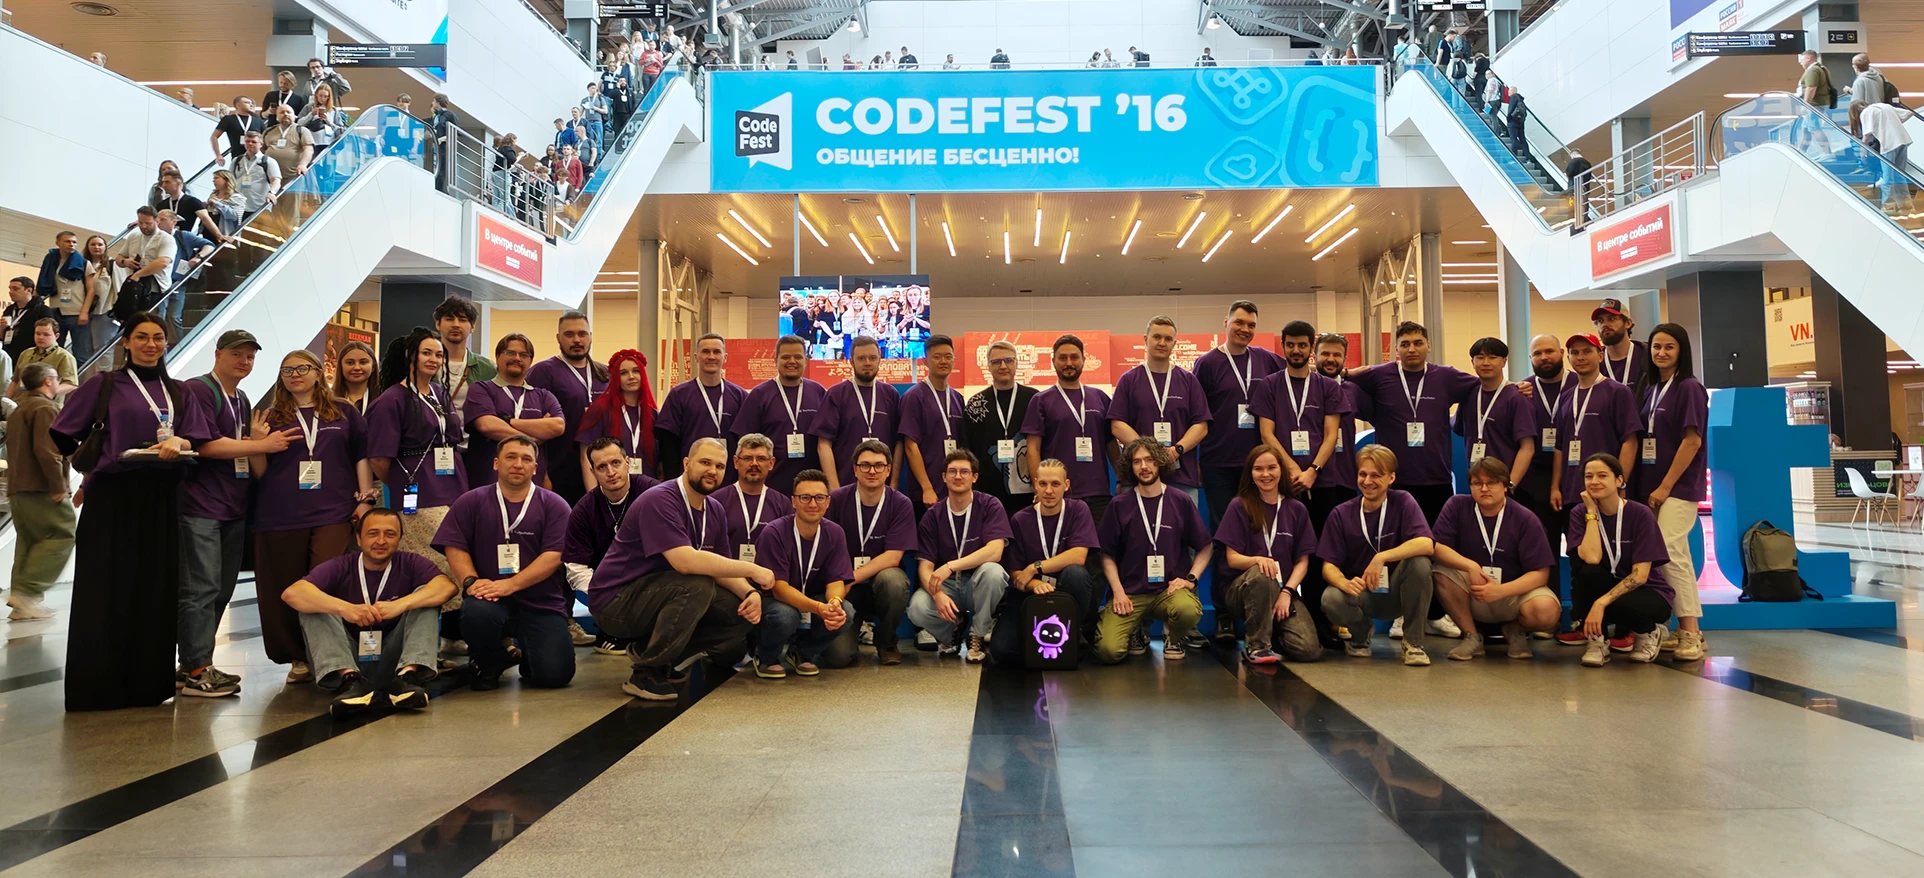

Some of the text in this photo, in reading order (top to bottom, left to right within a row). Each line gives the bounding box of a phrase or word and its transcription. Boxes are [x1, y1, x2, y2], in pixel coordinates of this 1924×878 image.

[1830, 33, 1836, 41] 2
[739, 116, 777, 133] Code
[817, 96, 1101, 134] CODEFEST
[740, 134, 773, 150] Fest
[817, 148, 1080, 168] ОБЩЕНИЕ БЕСЦЕННО!
[485, 228, 538, 262] В центре событий
[1597, 241, 1603, 253] В
[1603, 233, 1629, 251] центре
[1629, 217, 1663, 240] событий
